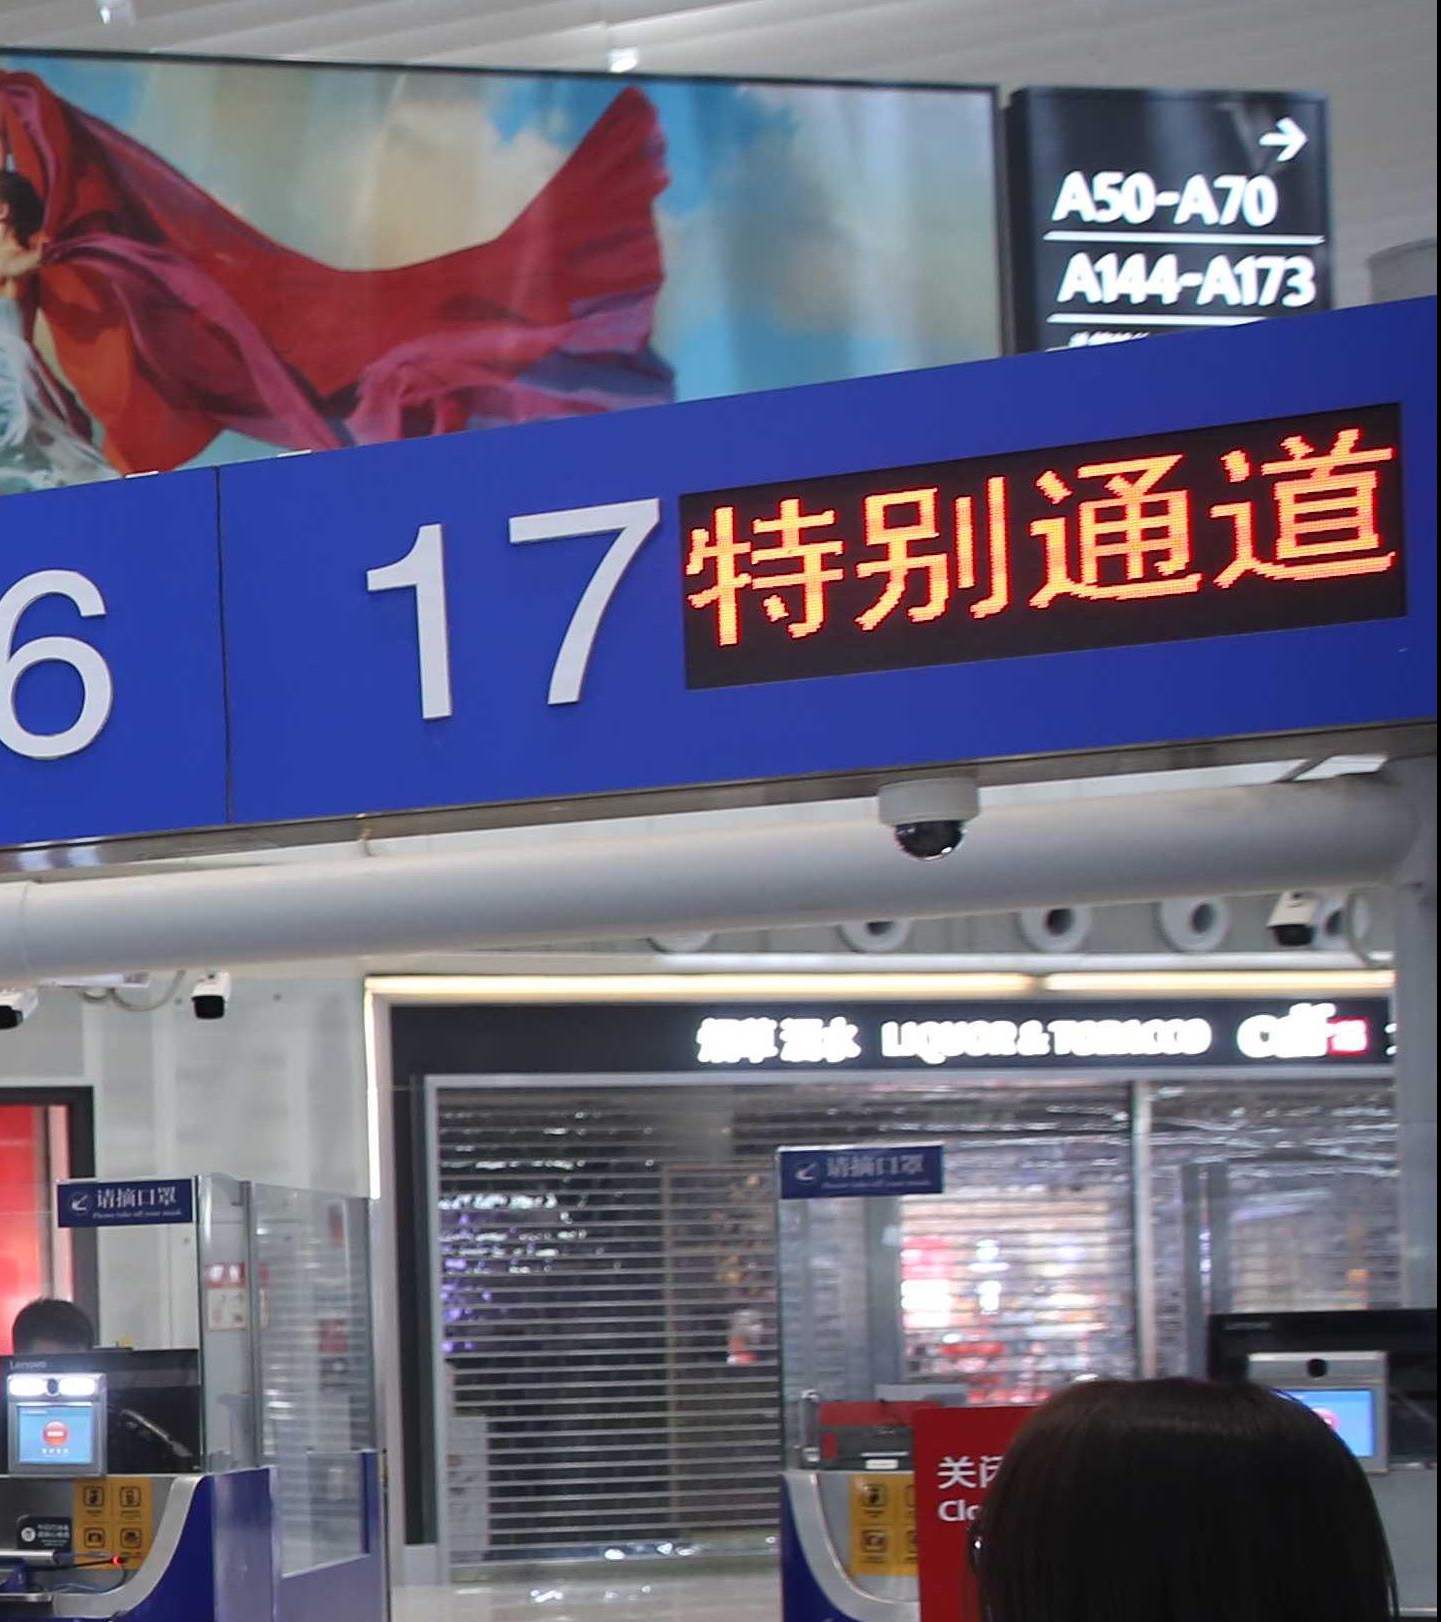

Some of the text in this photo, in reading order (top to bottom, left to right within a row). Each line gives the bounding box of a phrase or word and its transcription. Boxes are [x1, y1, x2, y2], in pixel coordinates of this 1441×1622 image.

[1052, 171, 1278, 227] A50-A70
[1057, 252, 1316, 307] A144-A173
[686, 427, 1395, 647] 特别通道
[367, 498, 659, 718] 17
[97, 1186, 176, 1208] 请摘口罩
